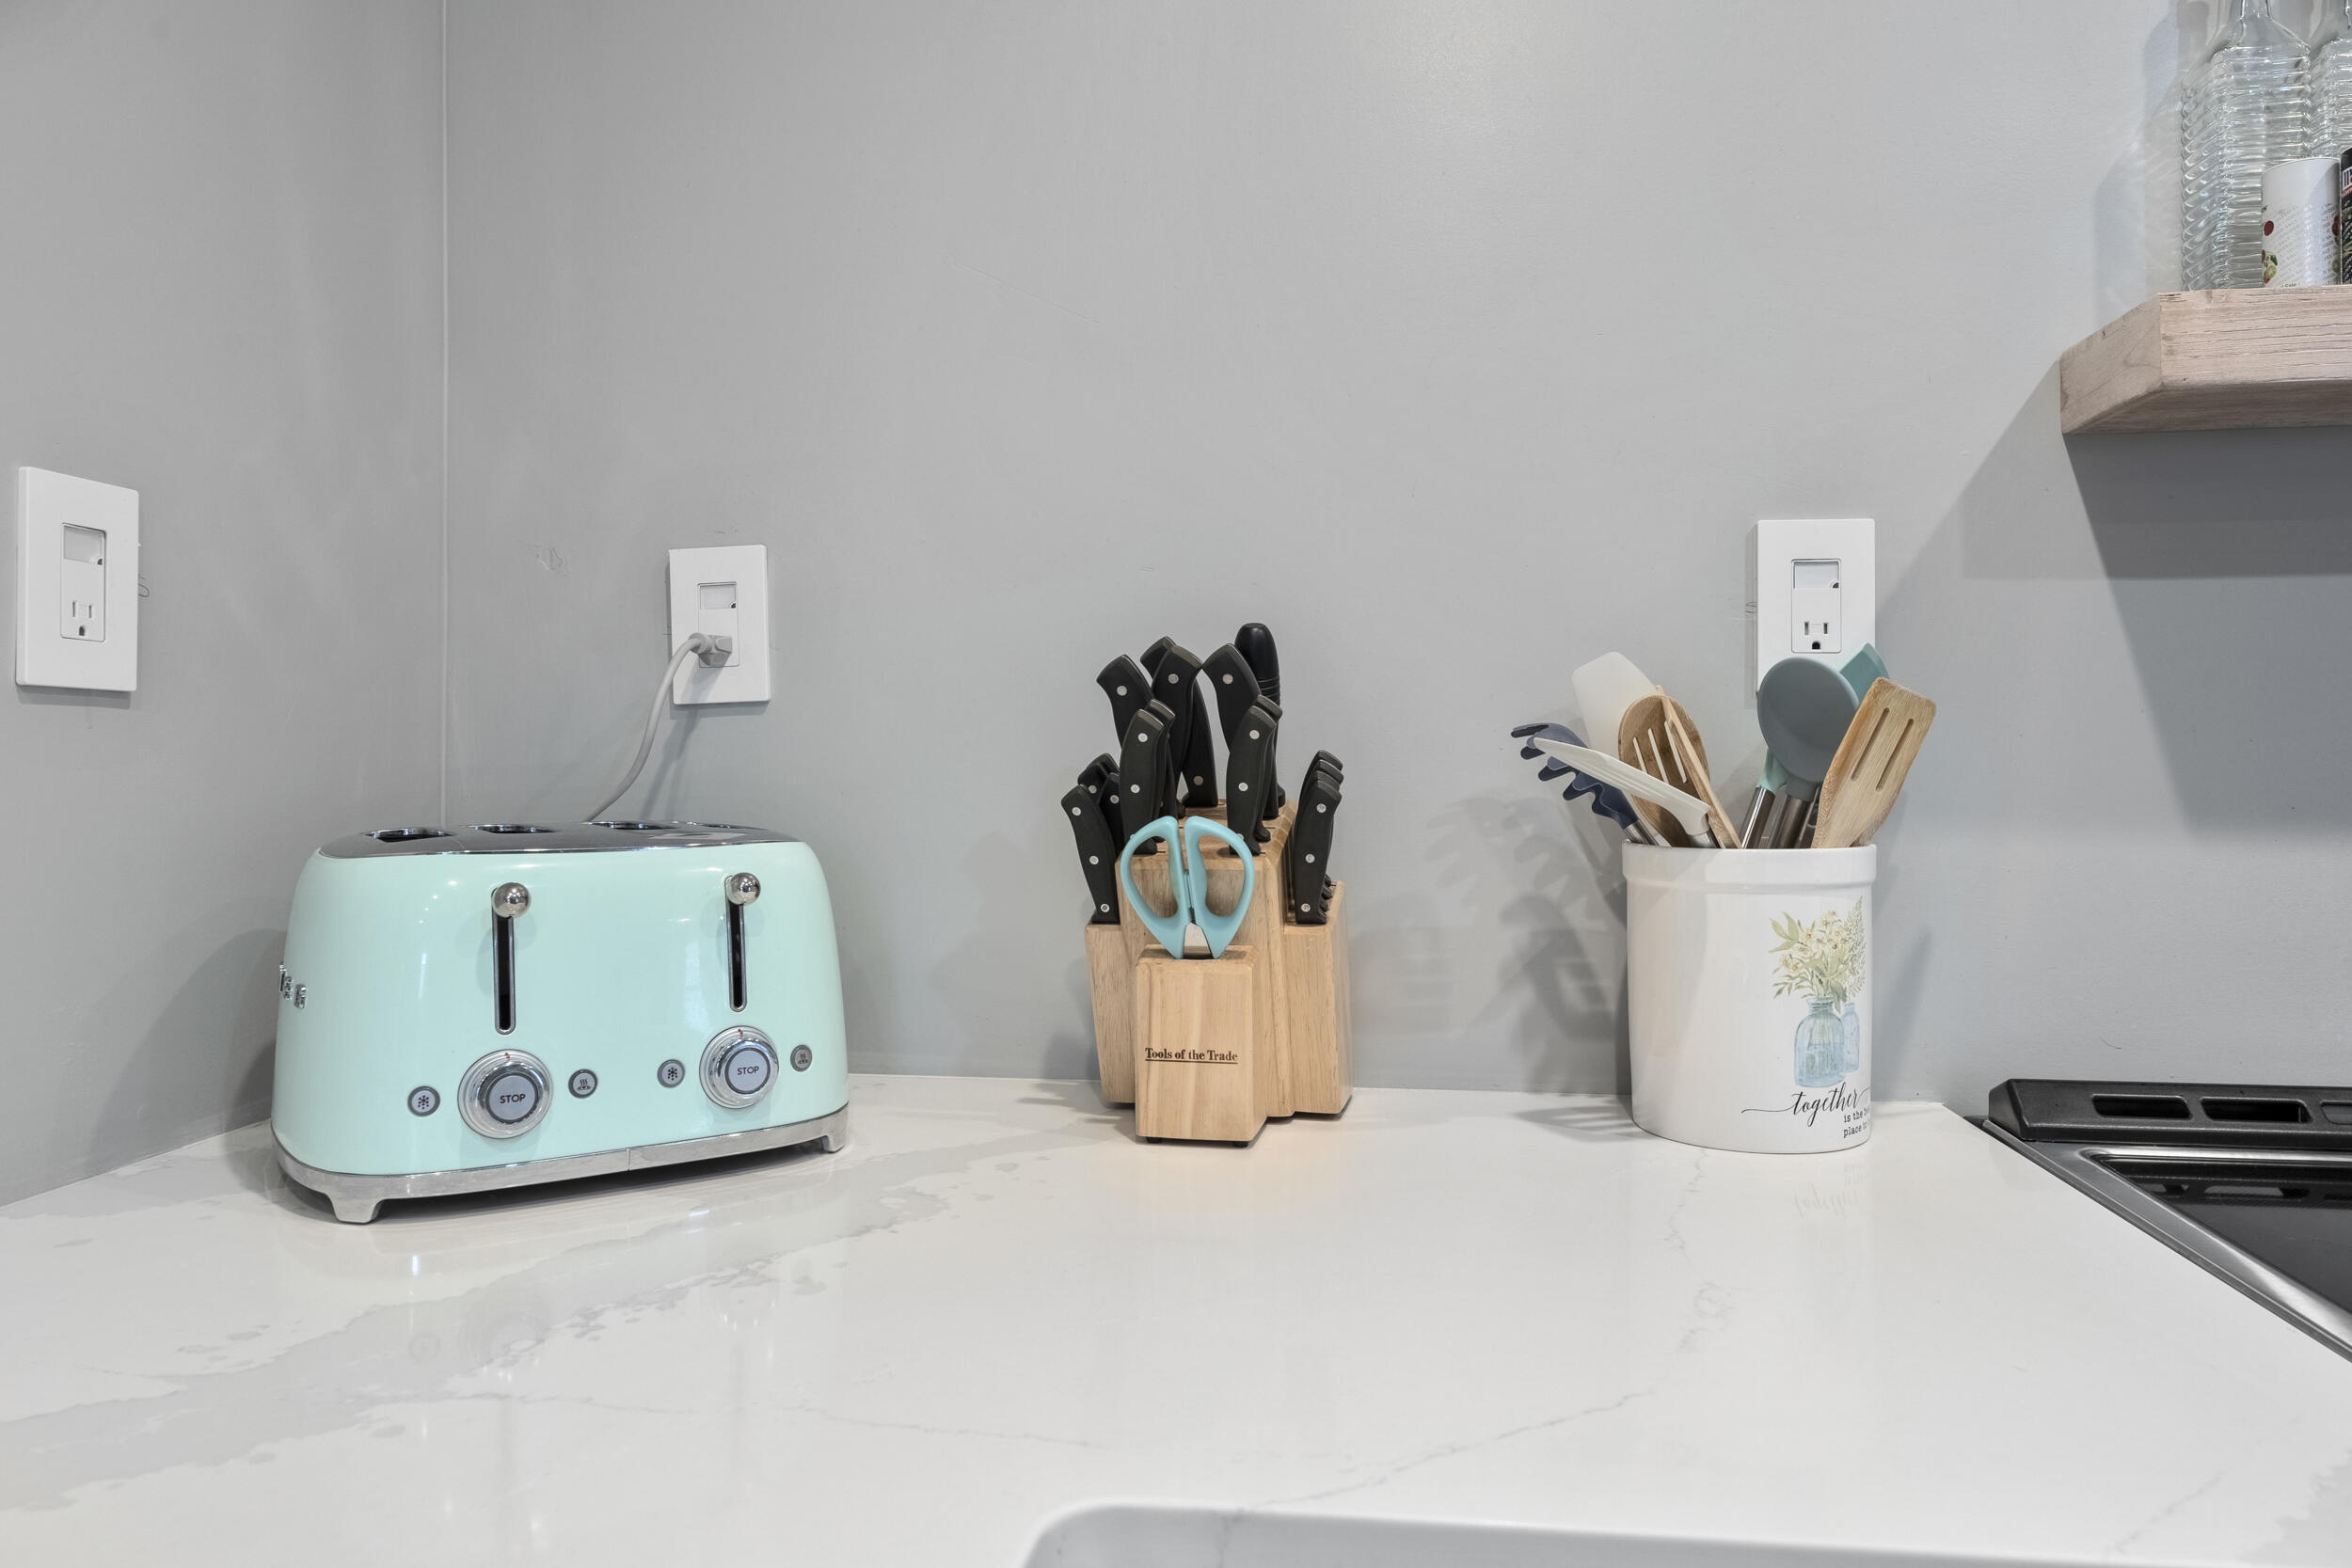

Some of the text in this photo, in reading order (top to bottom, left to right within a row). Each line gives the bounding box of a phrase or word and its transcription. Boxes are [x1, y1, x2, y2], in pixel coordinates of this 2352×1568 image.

[1145, 1048, 1238, 1062] Tools of the Trade
[737, 1066, 759, 1075] STOP
[500, 1093, 526, 1103] STOP
[1741, 1082, 1870, 1127] together
[1844, 1114, 1851, 1123] is
[1853, 1110, 1863, 1120] the
[1843, 1124, 1862, 1139] place
